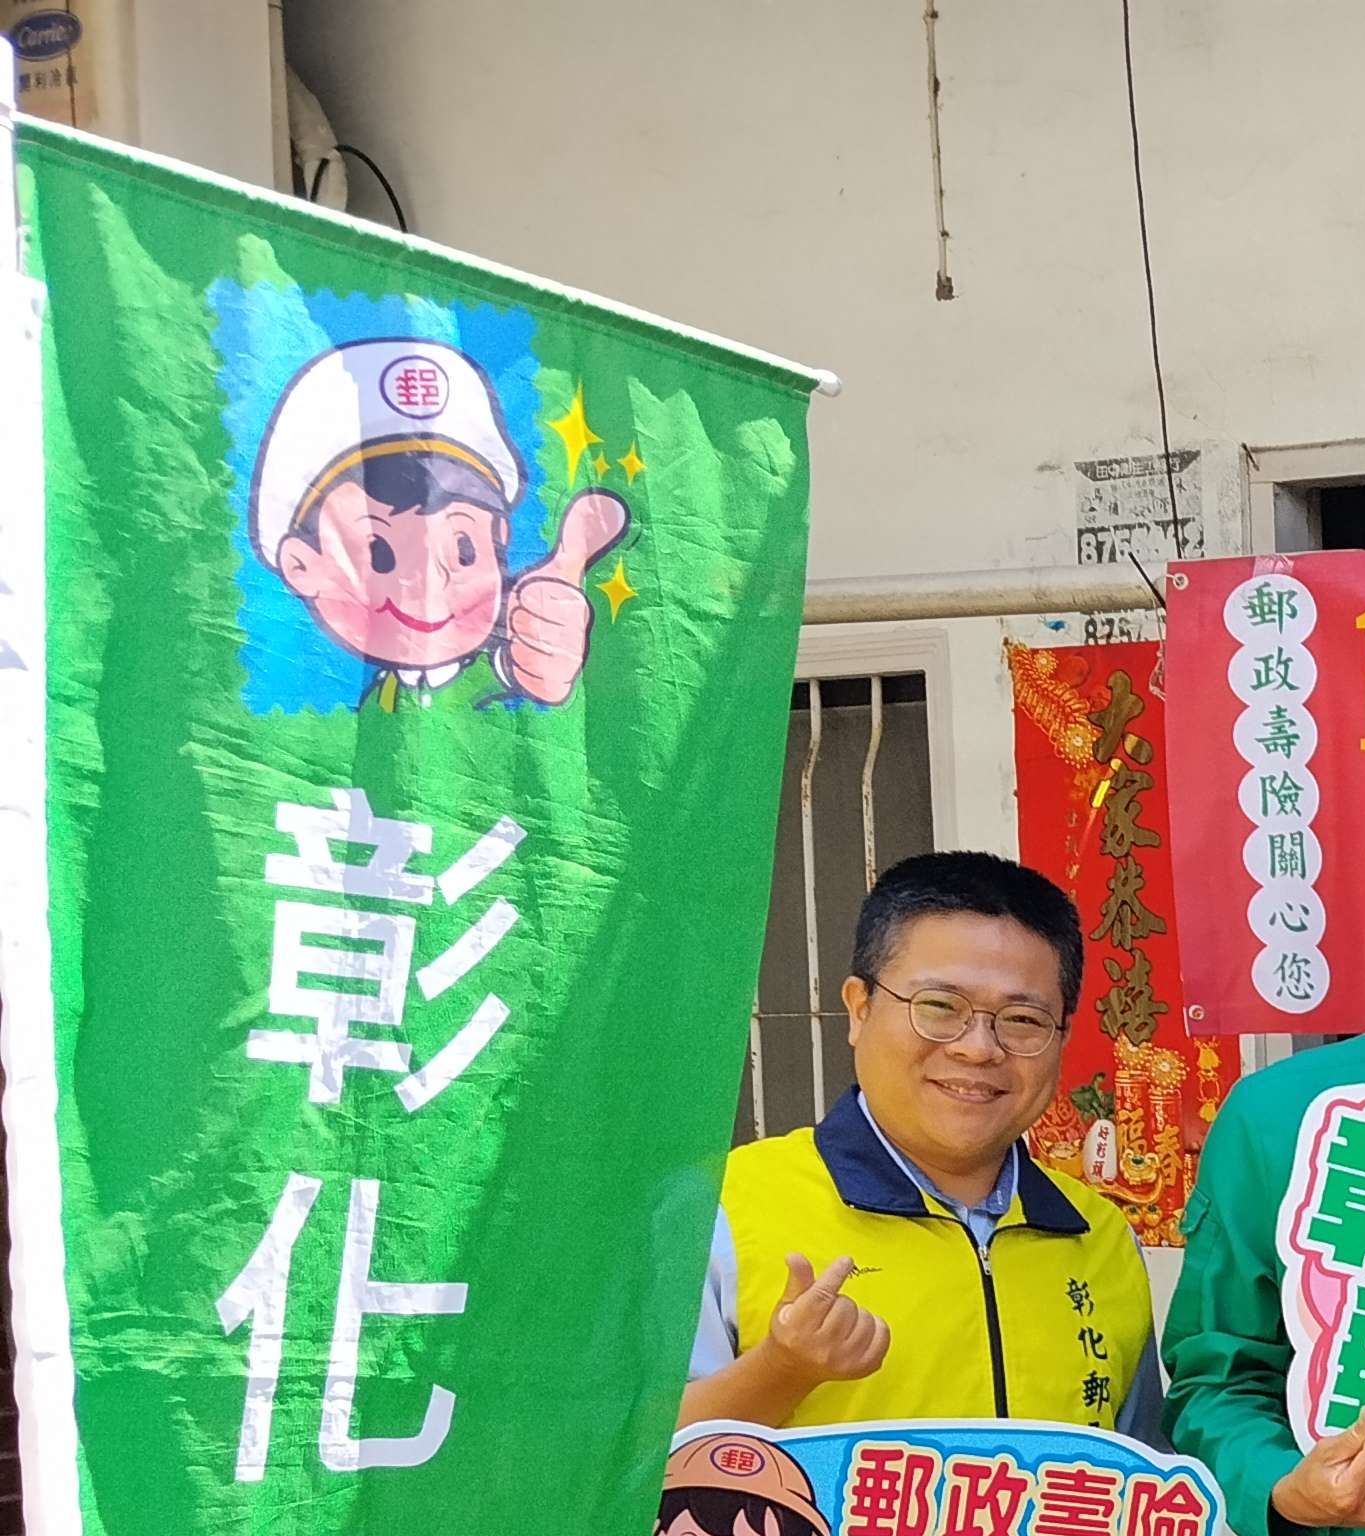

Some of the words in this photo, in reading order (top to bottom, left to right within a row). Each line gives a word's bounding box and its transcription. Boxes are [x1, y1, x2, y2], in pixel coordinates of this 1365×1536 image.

[1241, 582, 1316, 1002] 郵政壽險關心您
[1066, 1277, 1111, 1427] 彰化郵
